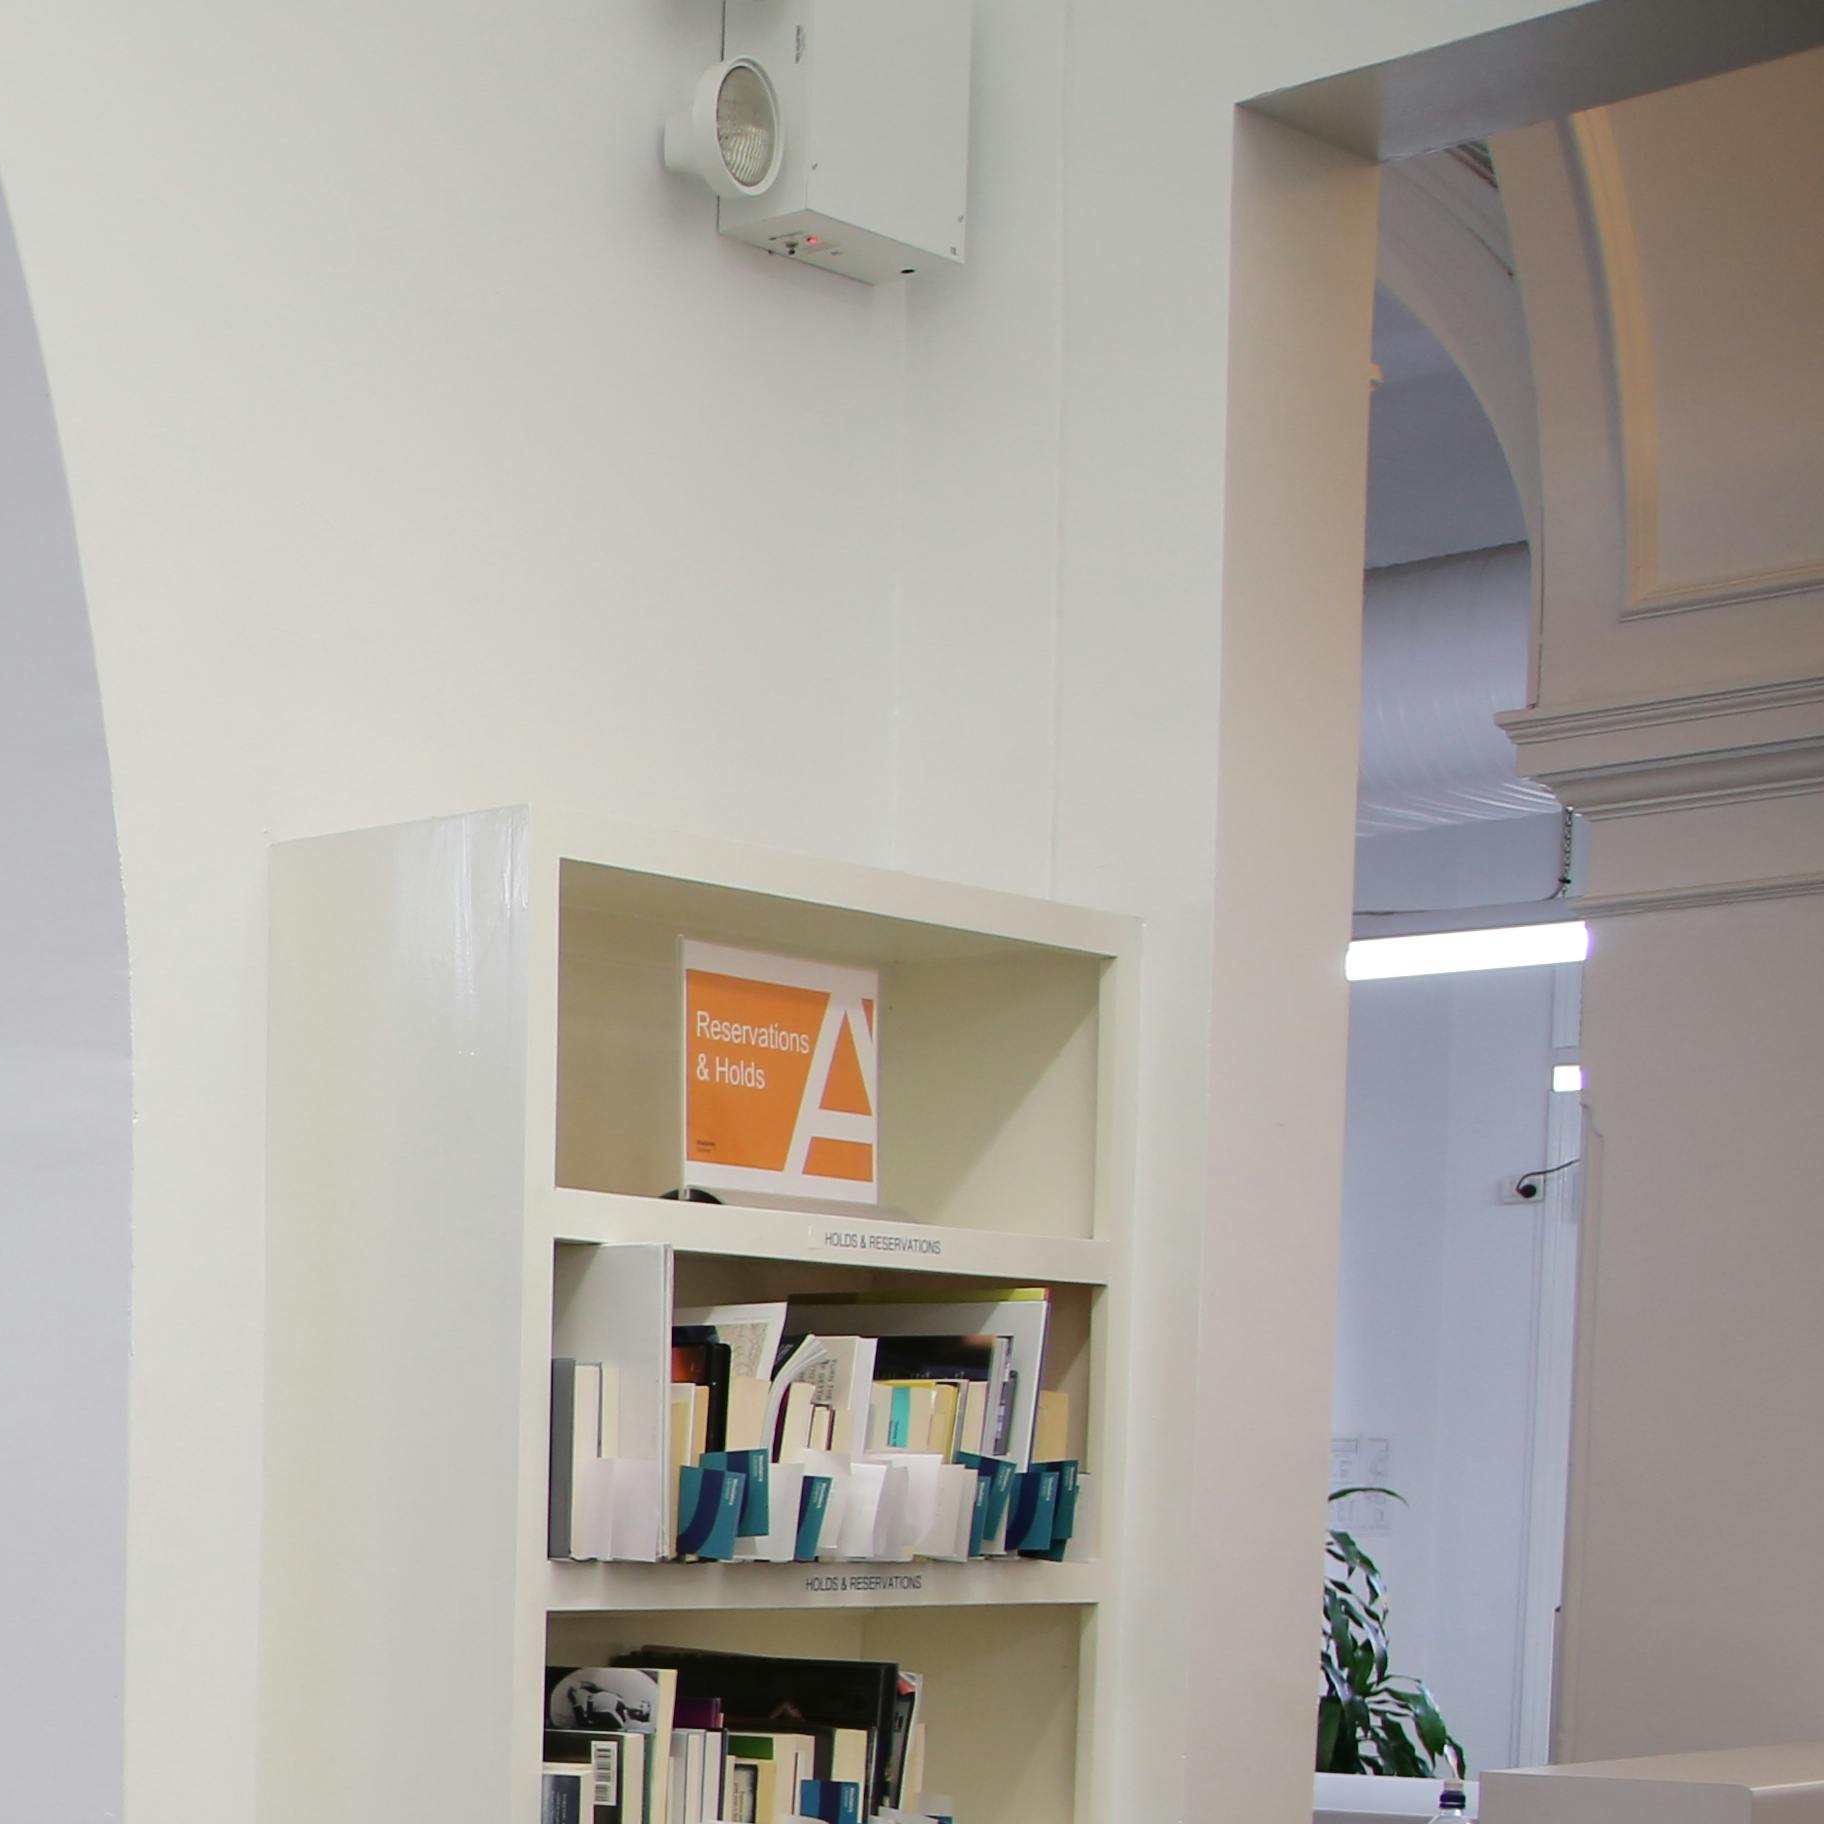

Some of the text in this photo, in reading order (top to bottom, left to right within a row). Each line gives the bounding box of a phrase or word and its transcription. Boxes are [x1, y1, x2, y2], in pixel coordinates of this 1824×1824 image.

[696, 1010, 809, 1054] Reservations
[696, 1053, 766, 1089] & Holds
[825, 1231, 941, 1255] HOLDS & RESERVATIONS
[806, 1575, 922, 1592] HOLDS & RESERVATIONS
